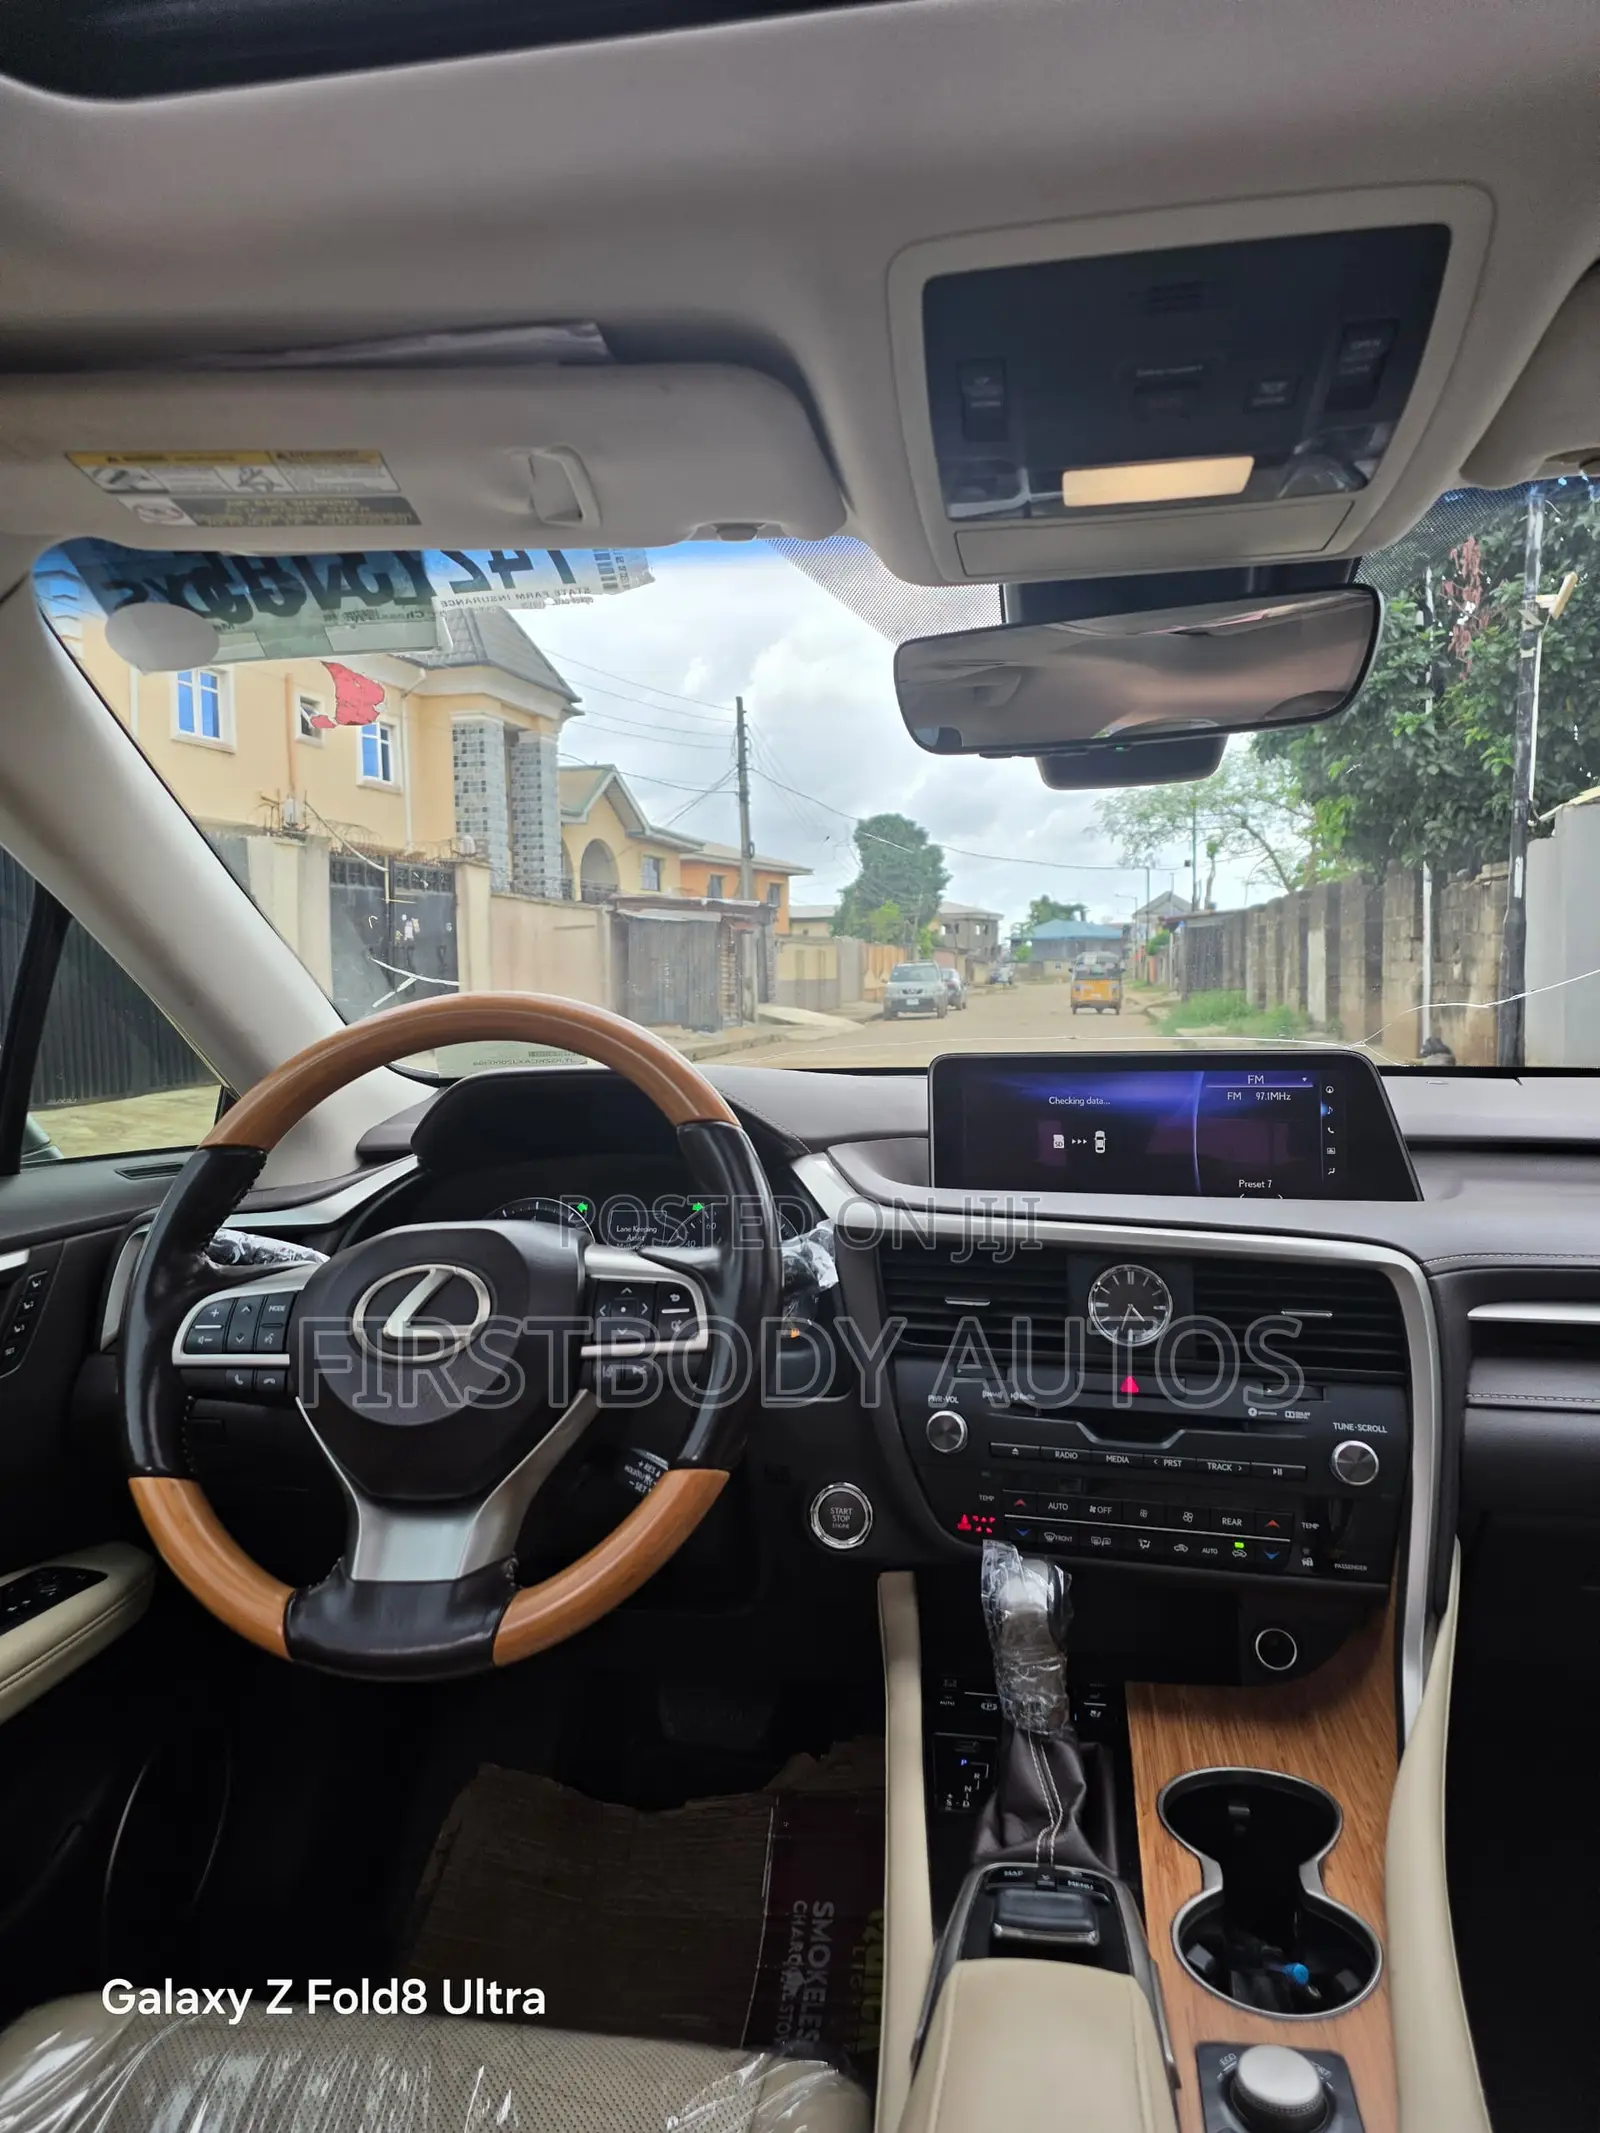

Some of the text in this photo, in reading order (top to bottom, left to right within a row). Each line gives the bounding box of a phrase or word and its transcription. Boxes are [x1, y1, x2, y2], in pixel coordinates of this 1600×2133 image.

[1247, 1075, 1265, 1085] FM
[1227, 1091, 1292, 1102] FM 97.1MHz
[1048, 1096, 1111, 1107] Checking data...
[1238, 1179, 1273, 1189] Preset 7
[616, 1225, 658, 1234] Lane Keeping
[268, 1304, 286, 1313] MODE
[1055, 1450, 1078, 1460] RADIO
[1105, 1455, 1130, 1464] MEDIA
[1163, 1458, 1182, 1468] PRST
[1207, 1462, 1233, 1472] TRACK
[979, 1493, 996, 1502] TEMP
[1047, 1502, 1069, 1511] AUTO
[1097, 1505, 1113, 1514] OFF
[830, 1507, 853, 1516] START
[1221, 1517, 1243, 1527] REAR
[1301, 1521, 1320, 1530] TEMP
[1201, 1547, 1219, 1555] AUTO
[1219, 2053, 1237, 2065] ECO
